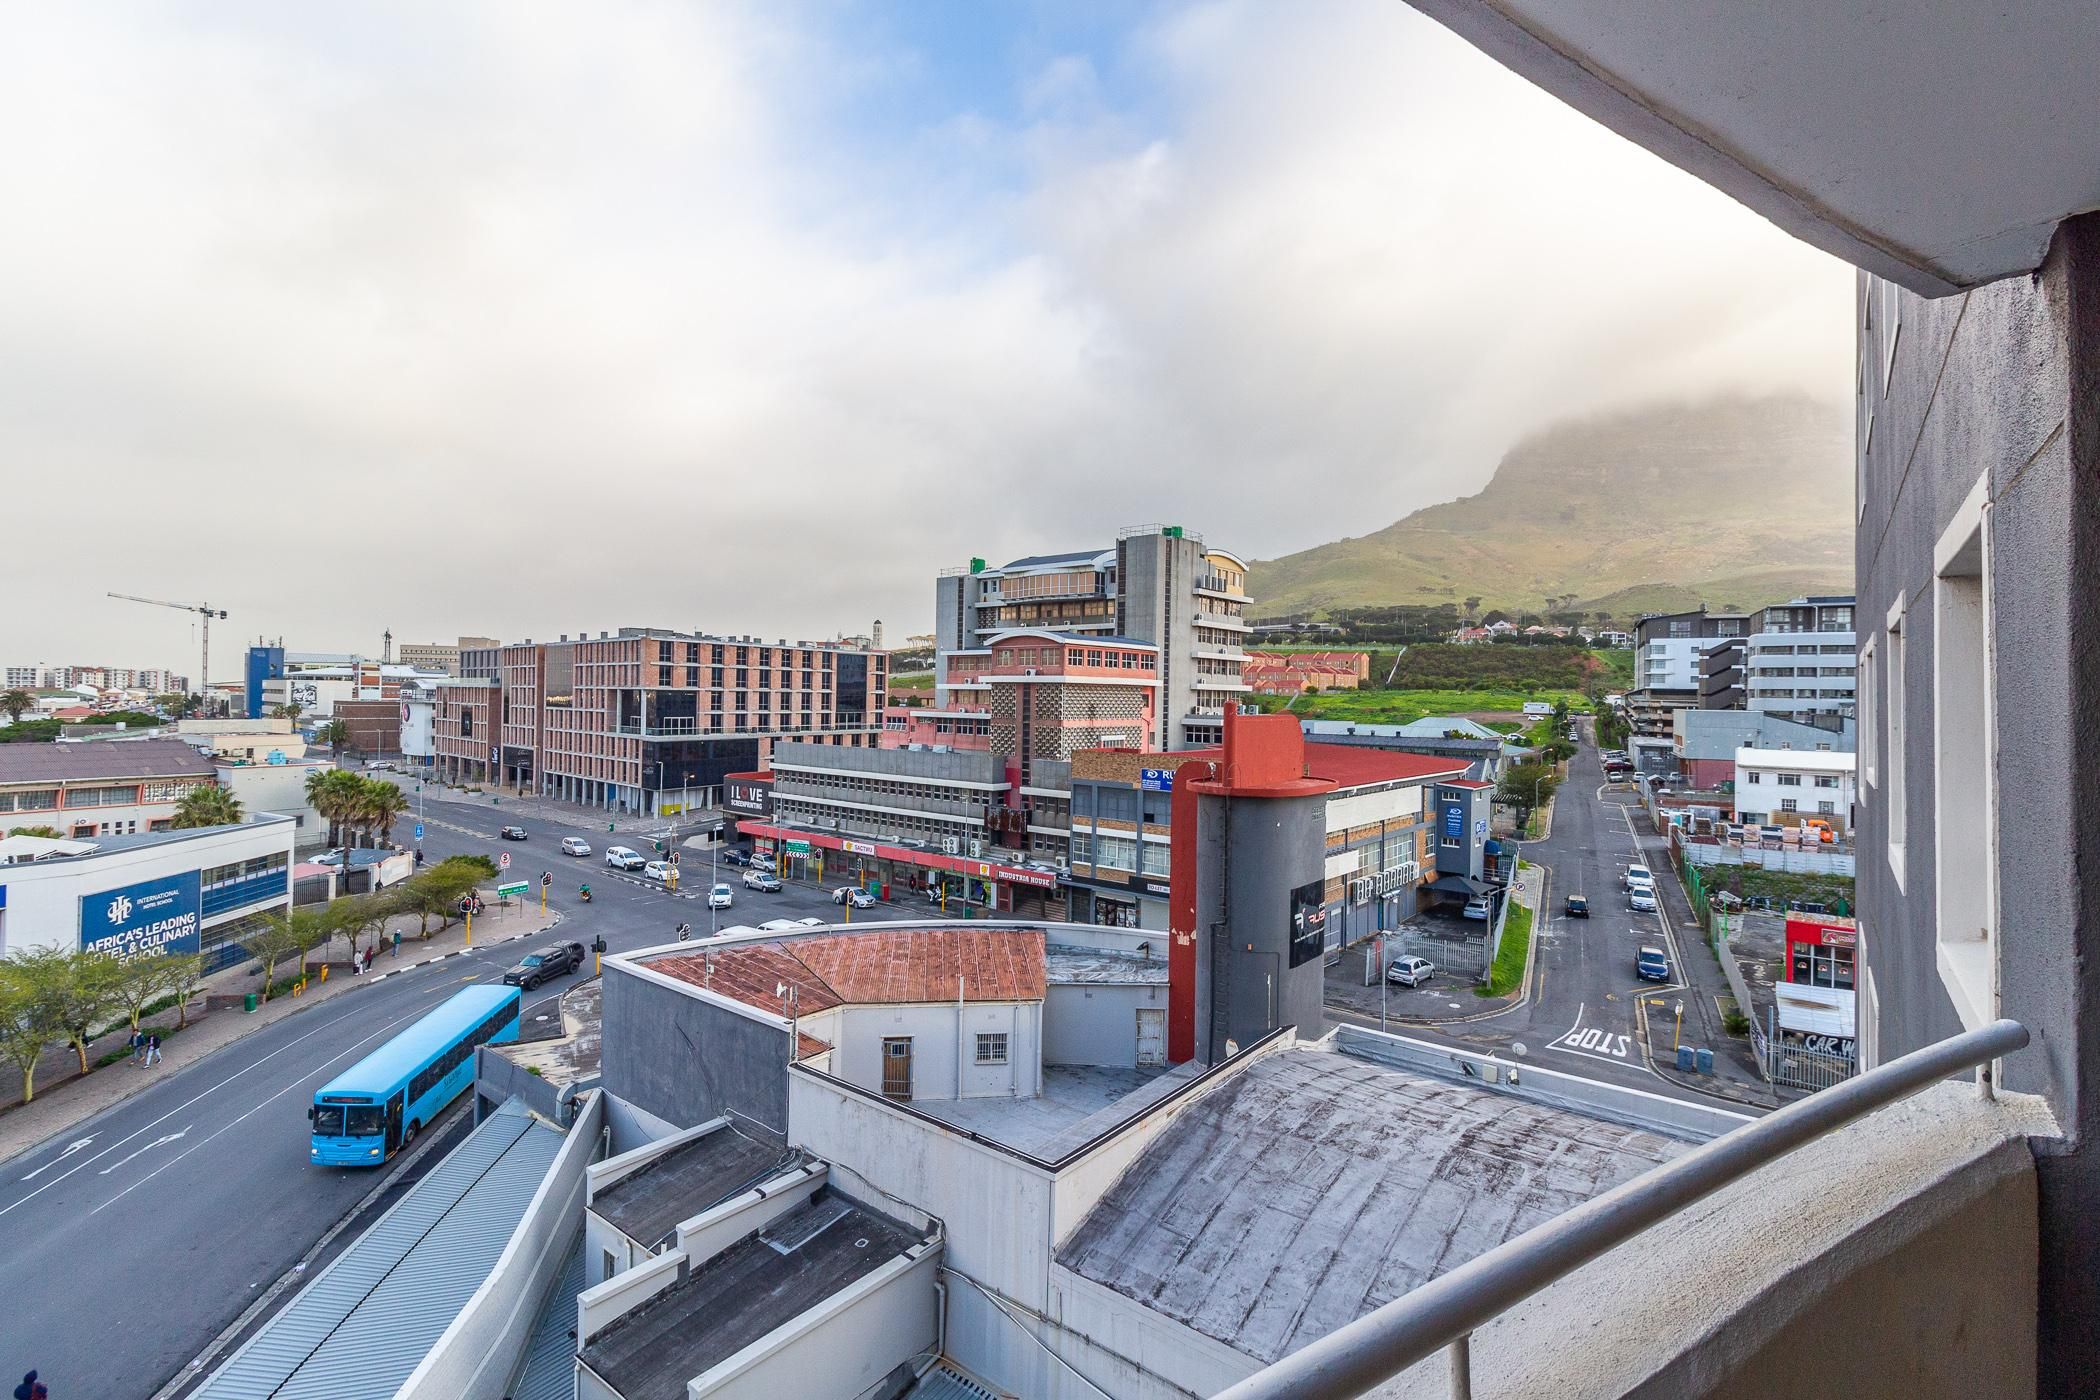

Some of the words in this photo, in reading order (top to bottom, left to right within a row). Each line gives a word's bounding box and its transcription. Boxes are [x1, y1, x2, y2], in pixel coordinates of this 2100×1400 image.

[731, 799, 762, 810] SCREENPRINTING
[1030, 875, 1050, 886] HOUSE
[137, 890, 179, 904] INTERNATIONAL
[156, 898, 173, 907] SCHOOL
[86, 928, 143, 954] AFRICA'S
[146, 912, 195, 936] LEADING
[128, 941, 138, 954] &
[140, 923, 197, 949] CULINARY
[1564, 1028, 1631, 1057] STOP
[1805, 1034, 1838, 1053] CAR
